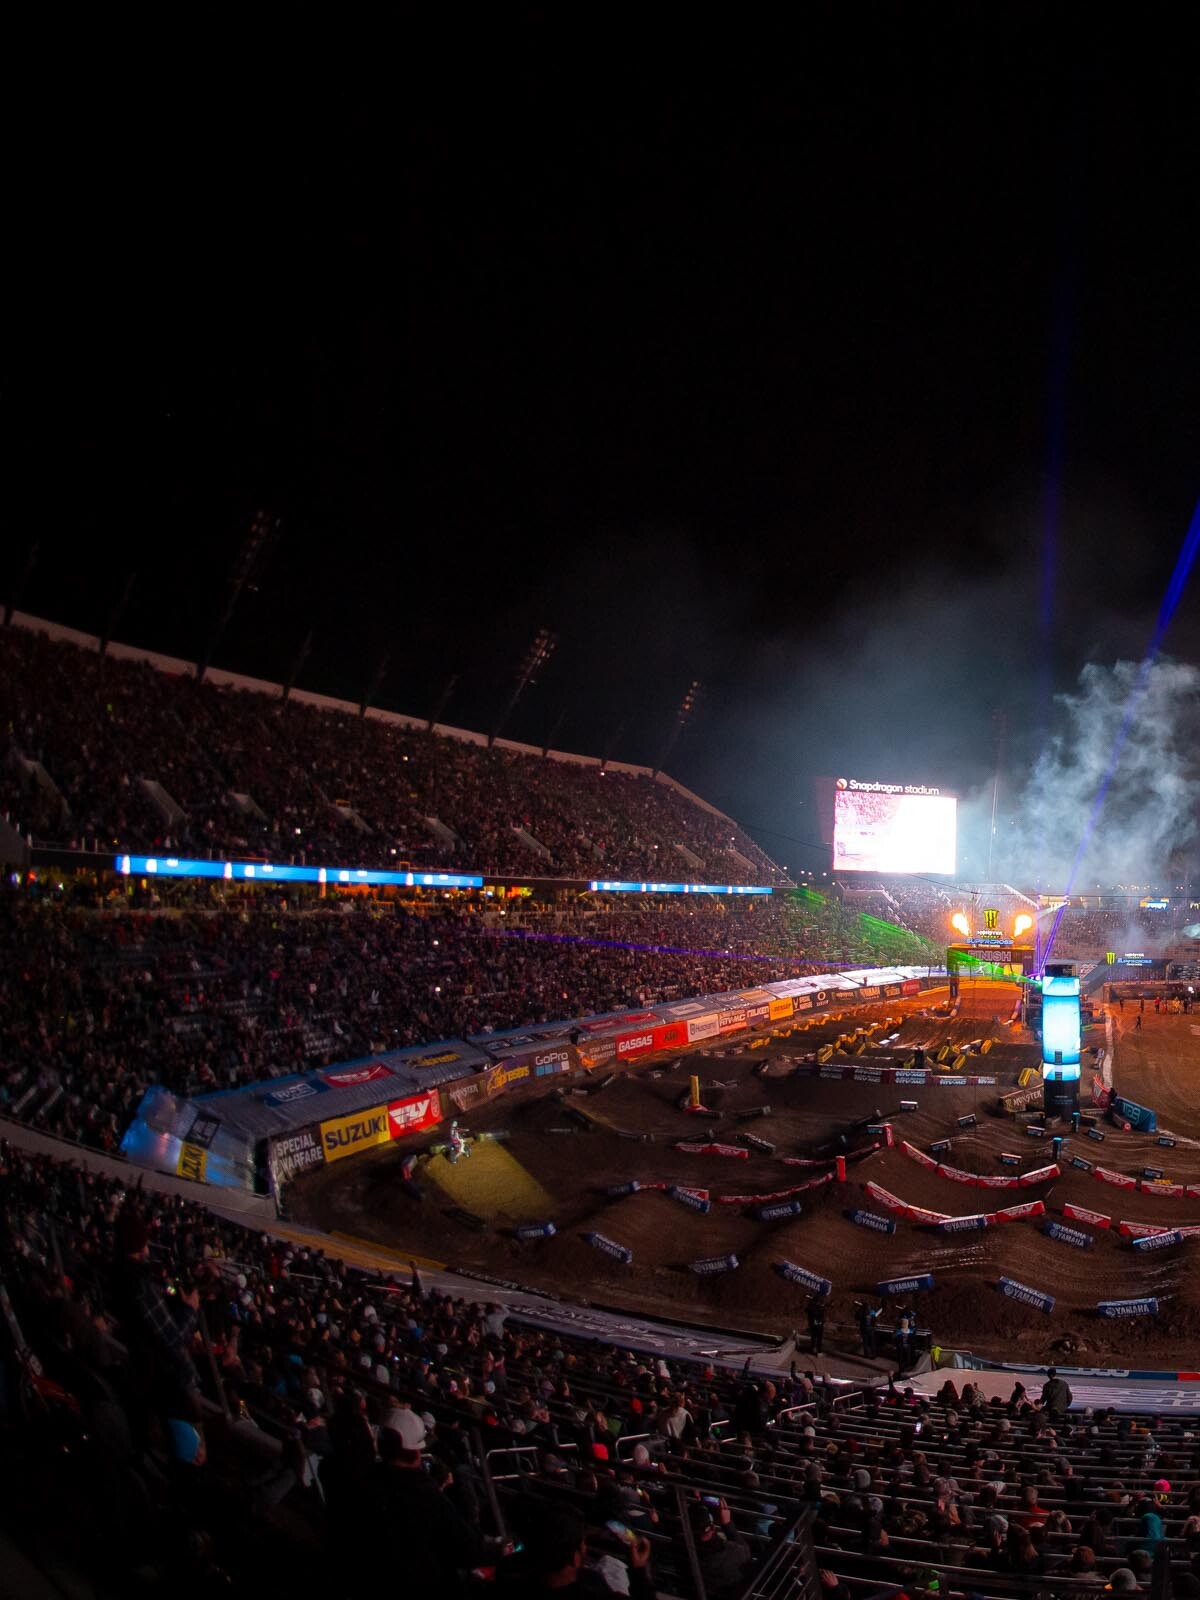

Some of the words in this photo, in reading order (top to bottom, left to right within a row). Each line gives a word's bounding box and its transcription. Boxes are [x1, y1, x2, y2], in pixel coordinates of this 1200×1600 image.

[849, 779, 903, 794] Snapdragon
[904, 784, 940, 796] stadium
[967, 949, 1012, 962] FINISH
[617, 1034, 654, 1053] GASGAS
[535, 1051, 569, 1066] GoPro
[388, 1099, 431, 1126] FLY
[324, 1115, 388, 1150] SUZUKI
[276, 1133, 316, 1156] SPECIAL
[278, 1145, 324, 1180] WARFARE
[862, 1217, 888, 1233] YAMAHA
[951, 1217, 979, 1231] YAMAHA
[1056, 1231, 1085, 1248] YAMAHA
[1147, 1234, 1177, 1249] YAMAHA
[792, 1271, 821, 1293] YAMAHA
[894, 1280, 920, 1292] YAMAHA
[1012, 1288, 1046, 1310] YAMAHA
[1114, 1303, 1150, 1316] YAMAHA
